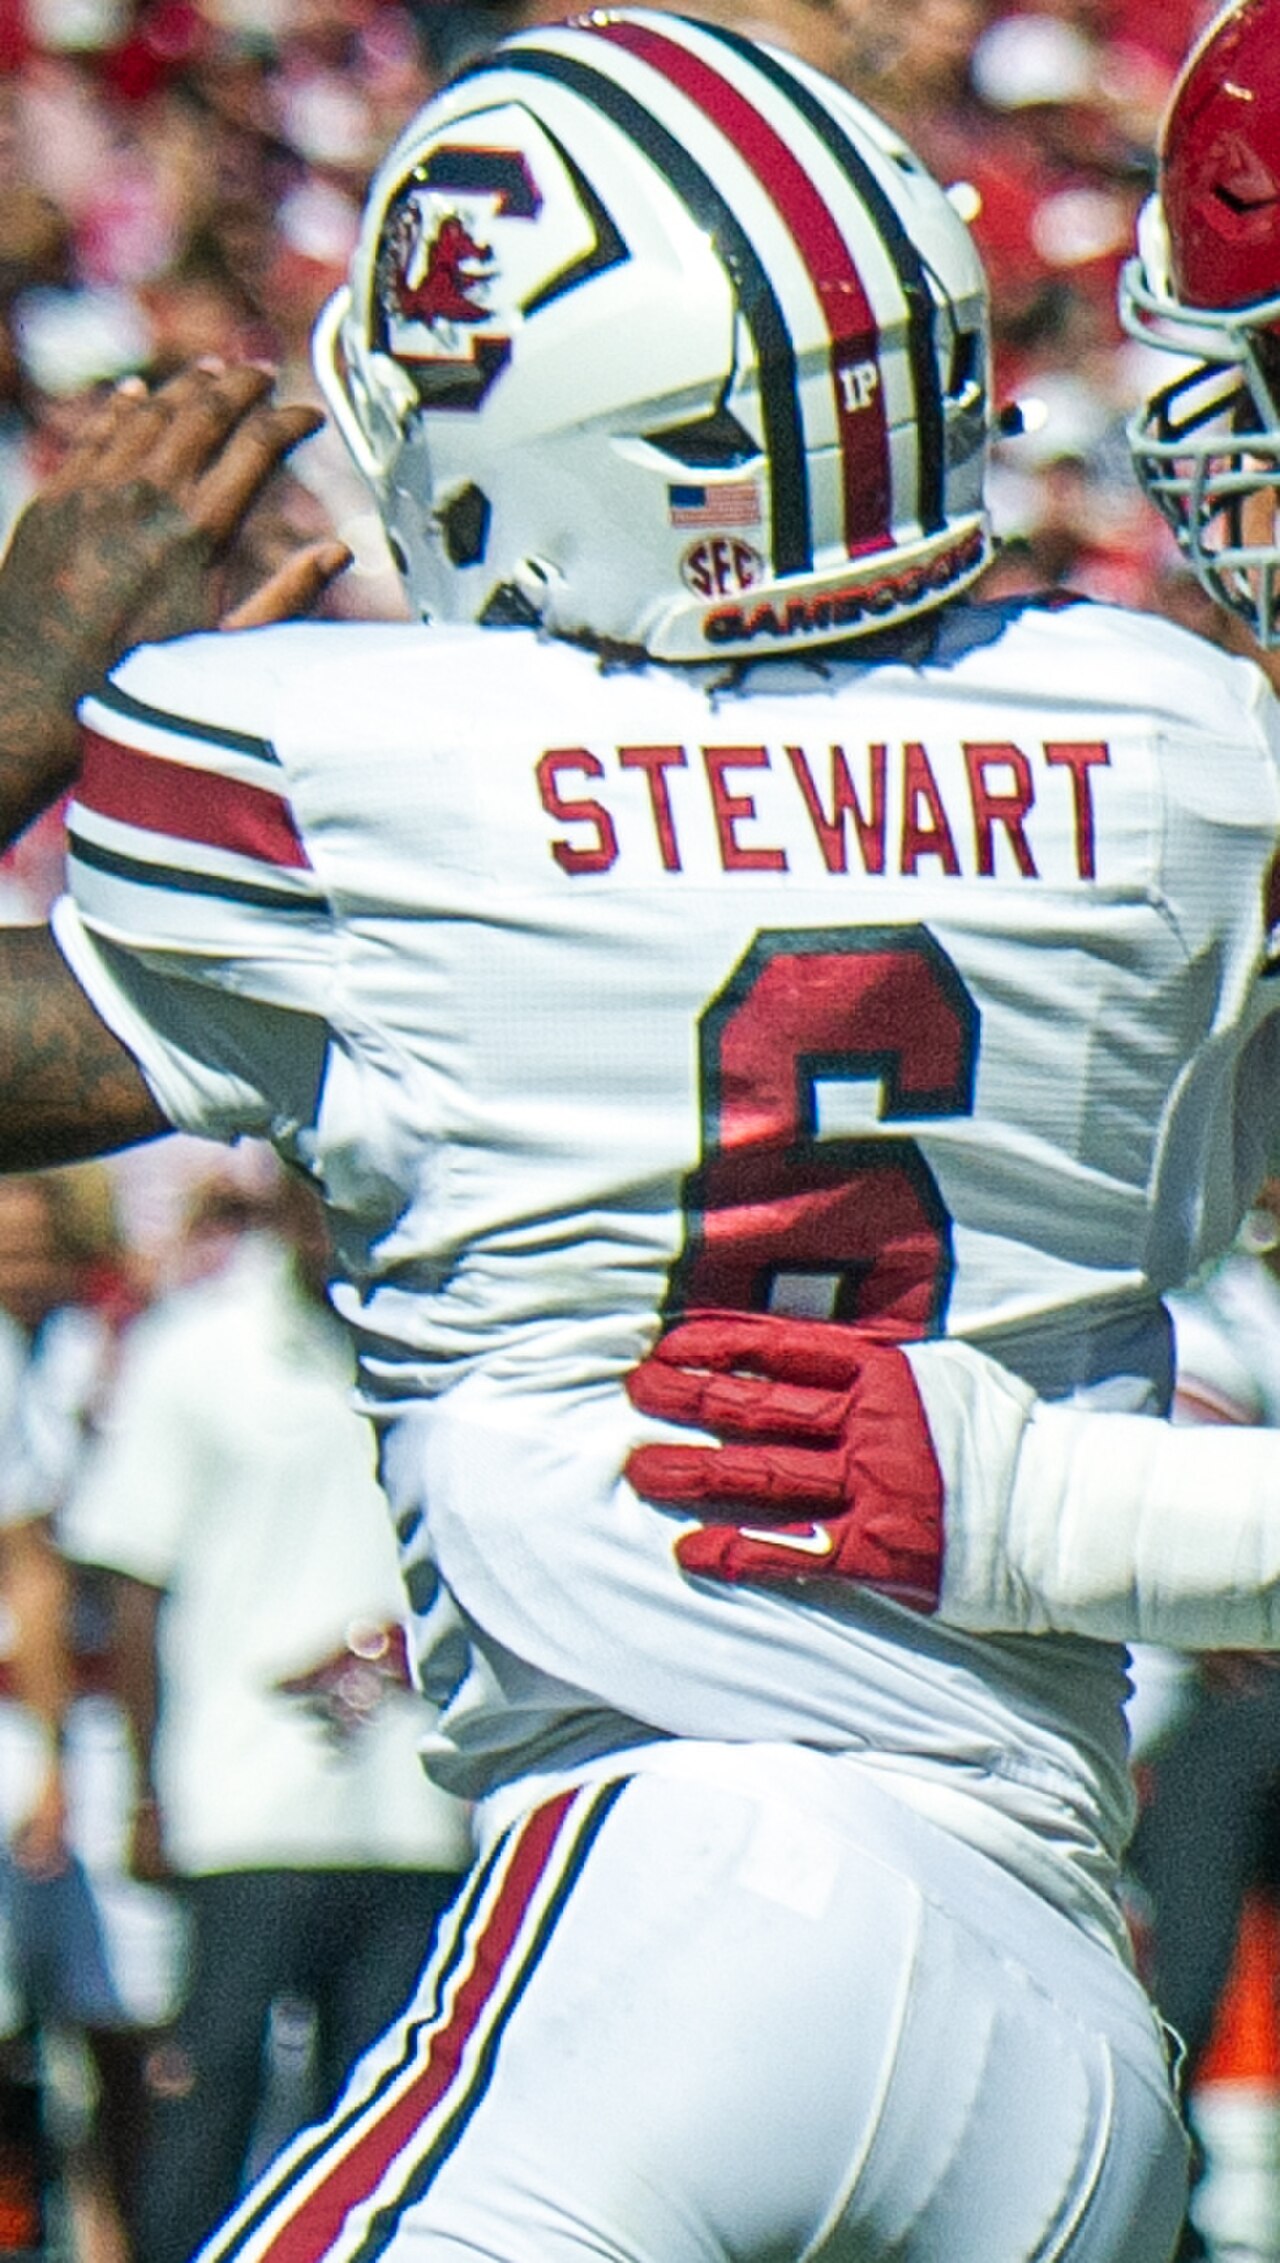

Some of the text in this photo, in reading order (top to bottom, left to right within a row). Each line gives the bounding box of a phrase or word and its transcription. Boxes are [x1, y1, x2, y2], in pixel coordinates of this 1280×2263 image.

[838, 360, 878, 412] IP
[534, 741, 1112, 880] STEWART
[660, 921, 981, 1342] 6
